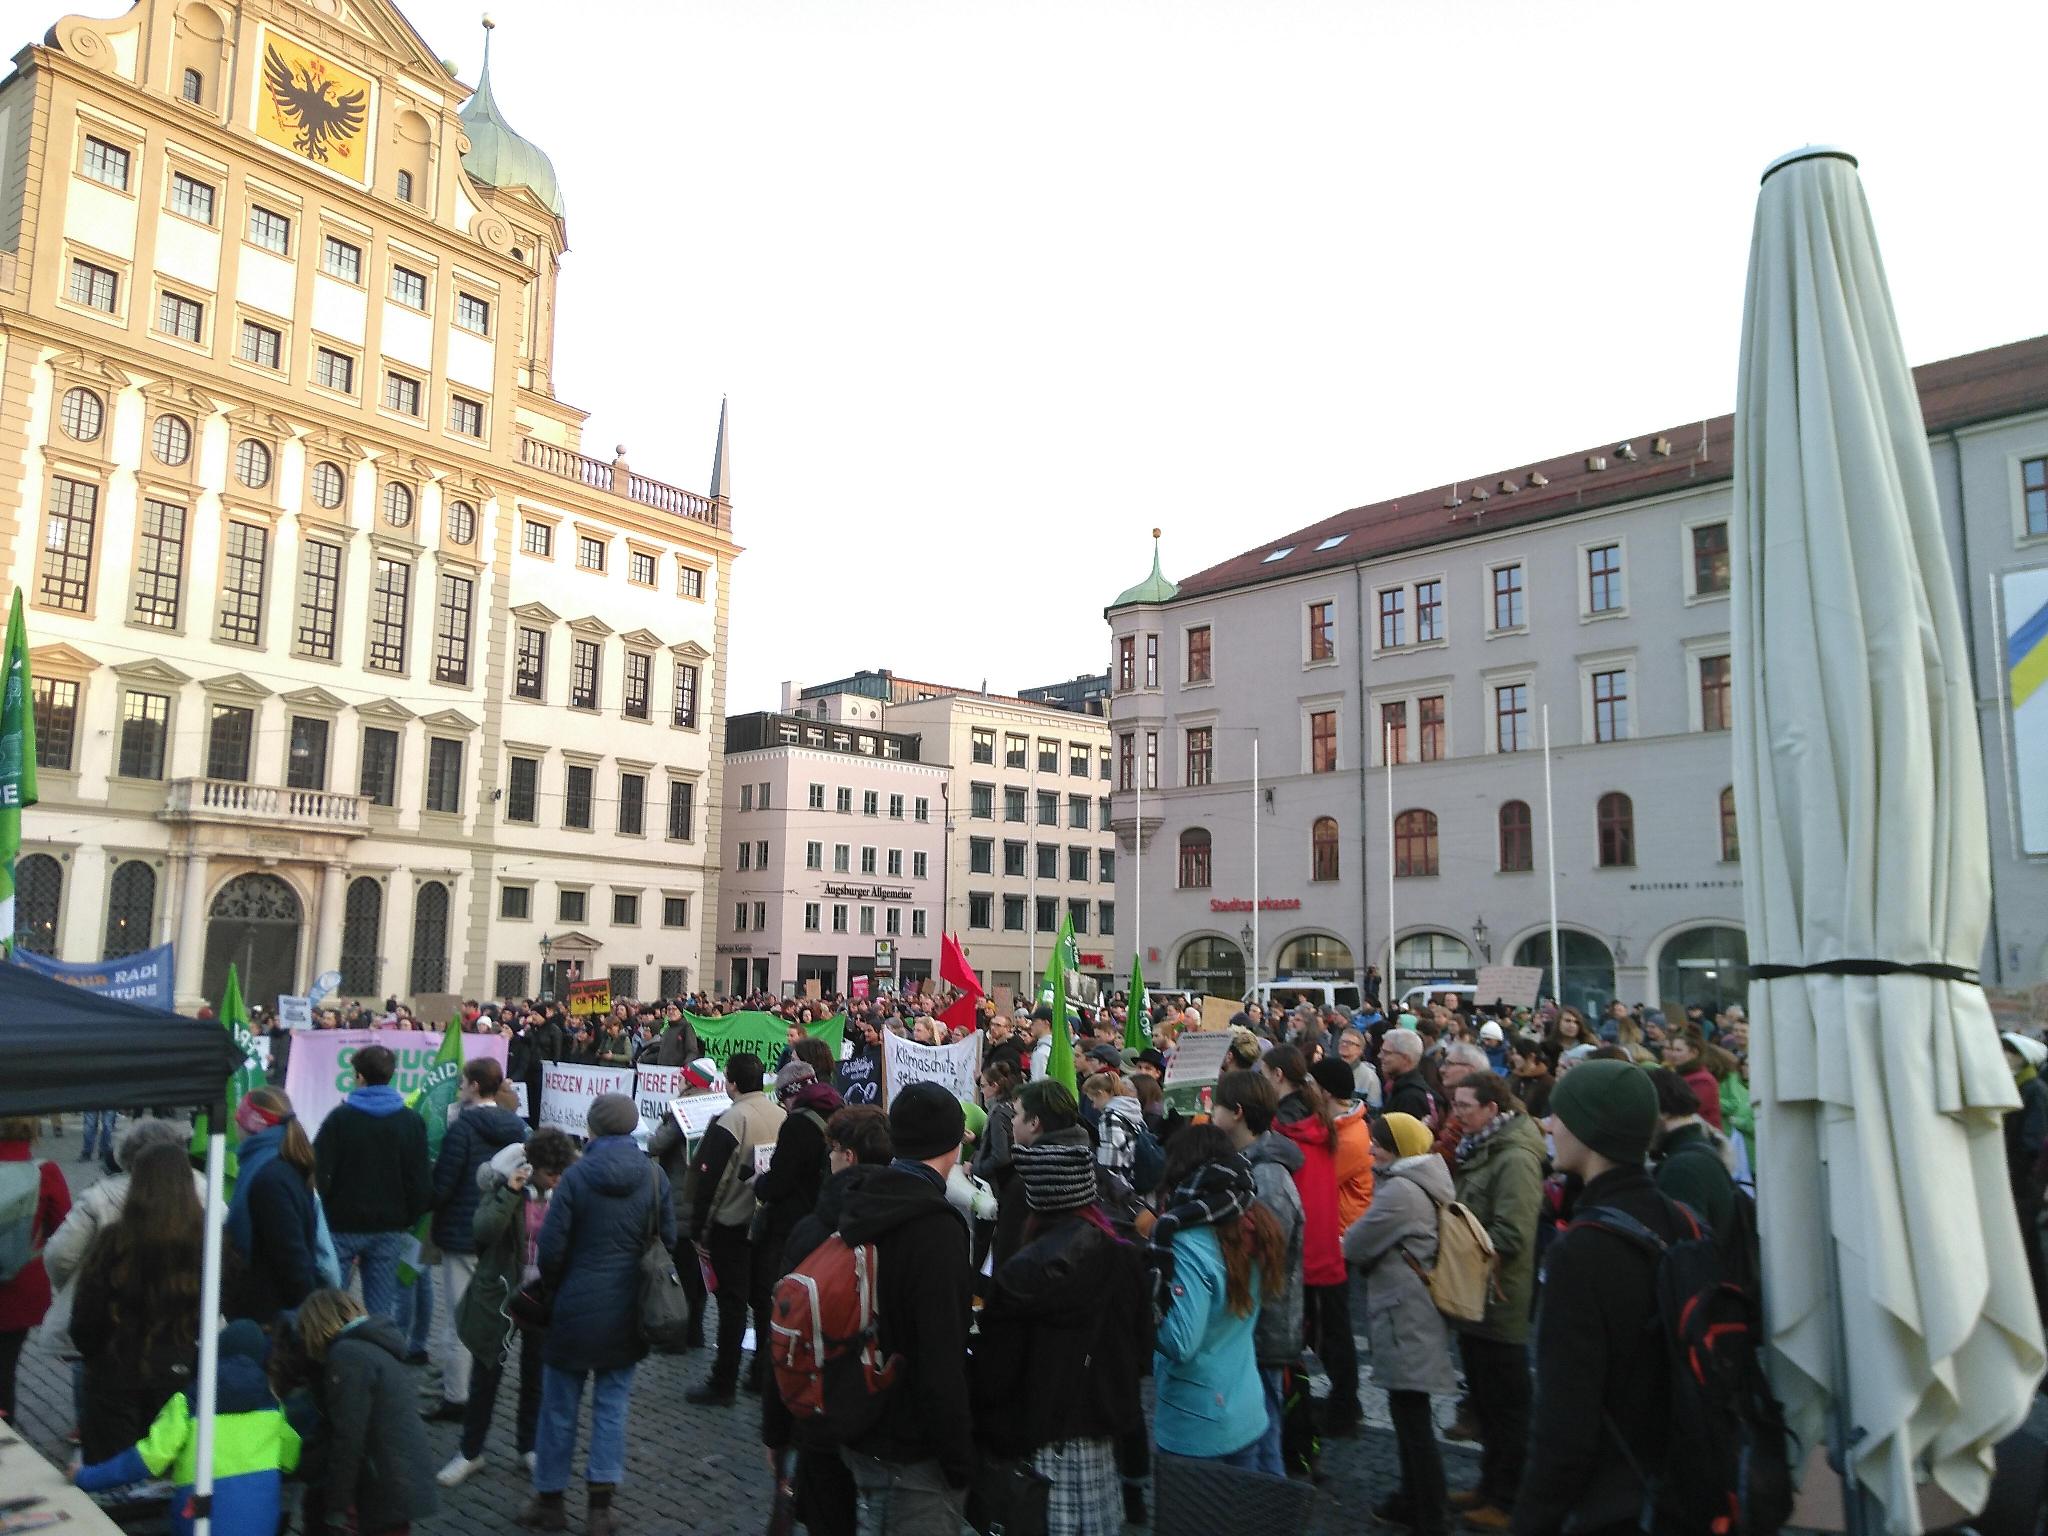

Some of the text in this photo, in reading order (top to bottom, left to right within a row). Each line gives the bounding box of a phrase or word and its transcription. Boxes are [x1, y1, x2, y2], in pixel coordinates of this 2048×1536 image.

[824, 882, 913, 900] Augsburger Allgemeine
[1210, 897, 1301, 912] Stadtsprkasse
[896, 1042, 957, 1075] Klimaschutz
[545, 1072, 582, 1094] HERZEN
[587, 1076, 611, 1097] AUF
[637, 1072, 667, 1094] TIERE
